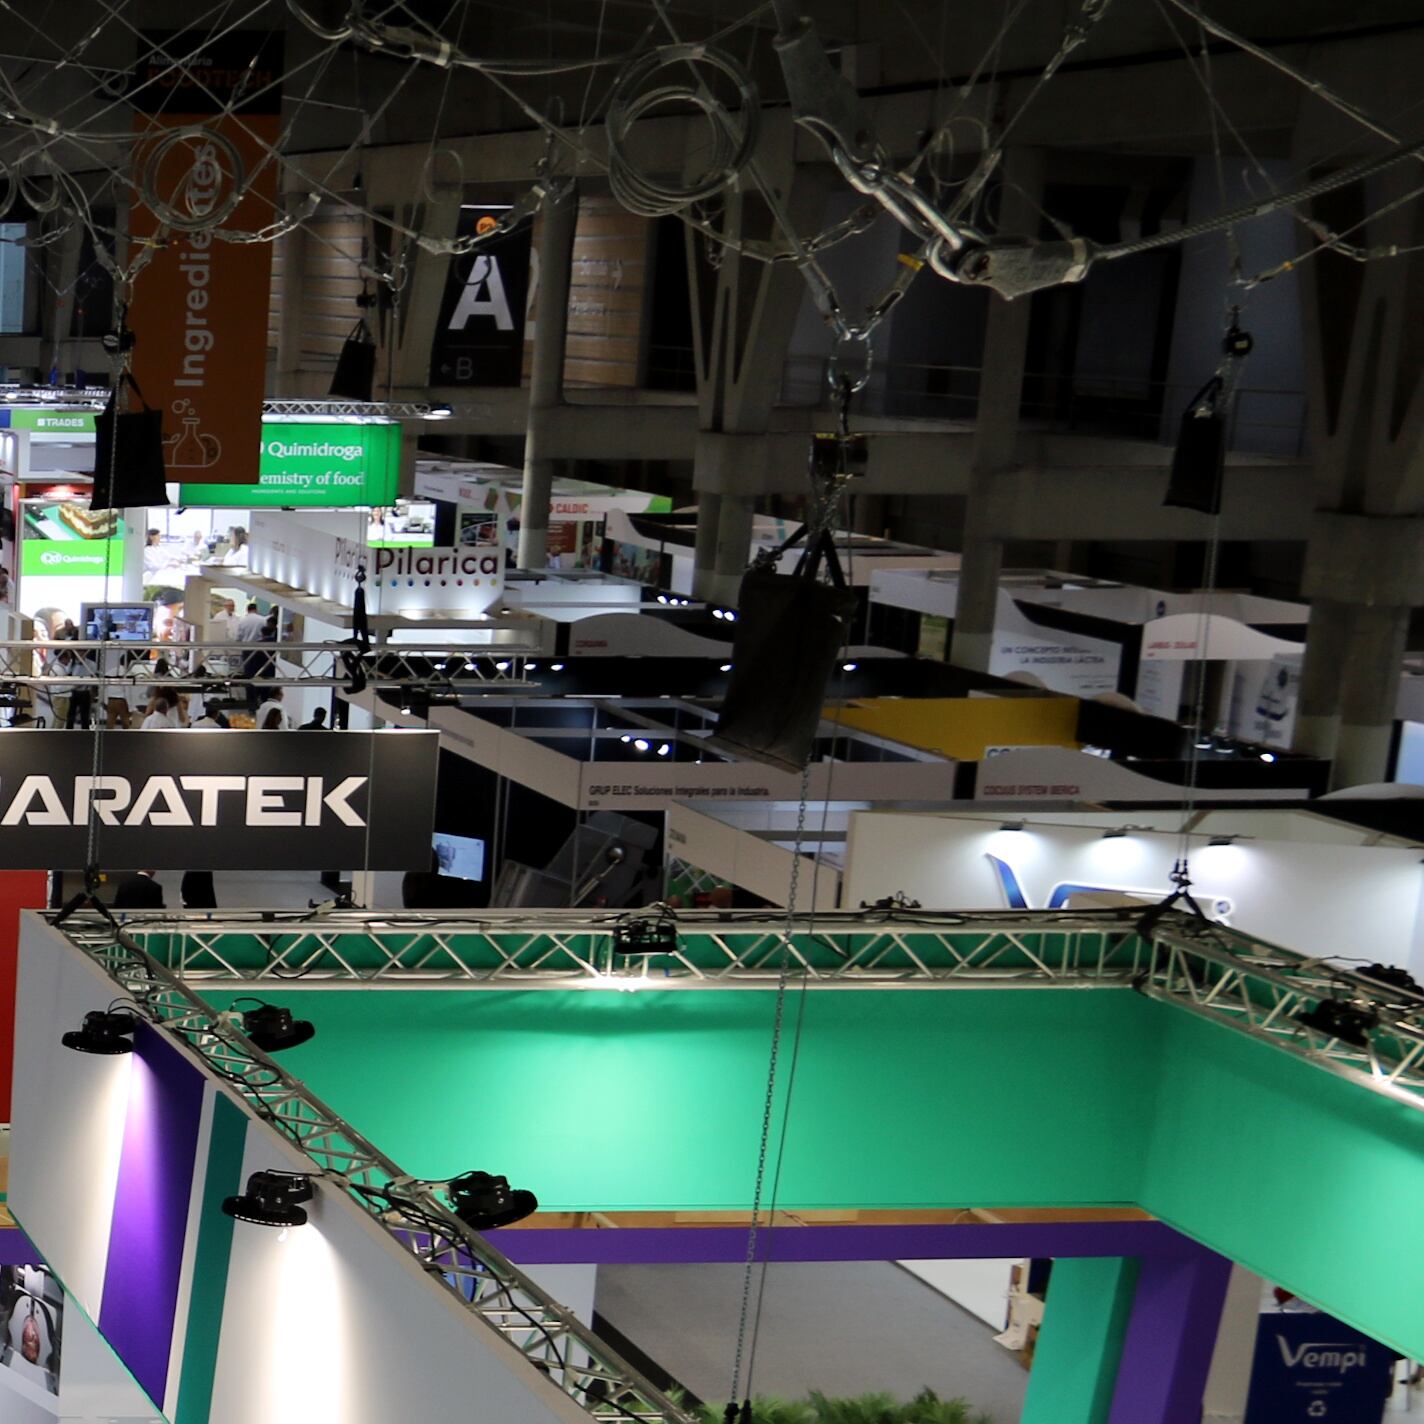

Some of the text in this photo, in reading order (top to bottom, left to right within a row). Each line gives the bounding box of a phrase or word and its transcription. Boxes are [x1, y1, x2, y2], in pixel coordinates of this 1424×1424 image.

[448, 255, 515, 331] A
[455, 356, 473, 380] B
[47, 418, 84, 427] TRADES
[268, 441, 364, 461] Quimidroga
[260, 470, 313, 488] emistry
[315, 471, 333, 485] of
[375, 545, 499, 576] Pilarica
[1276, 1333, 1367, 1374] Vempi
